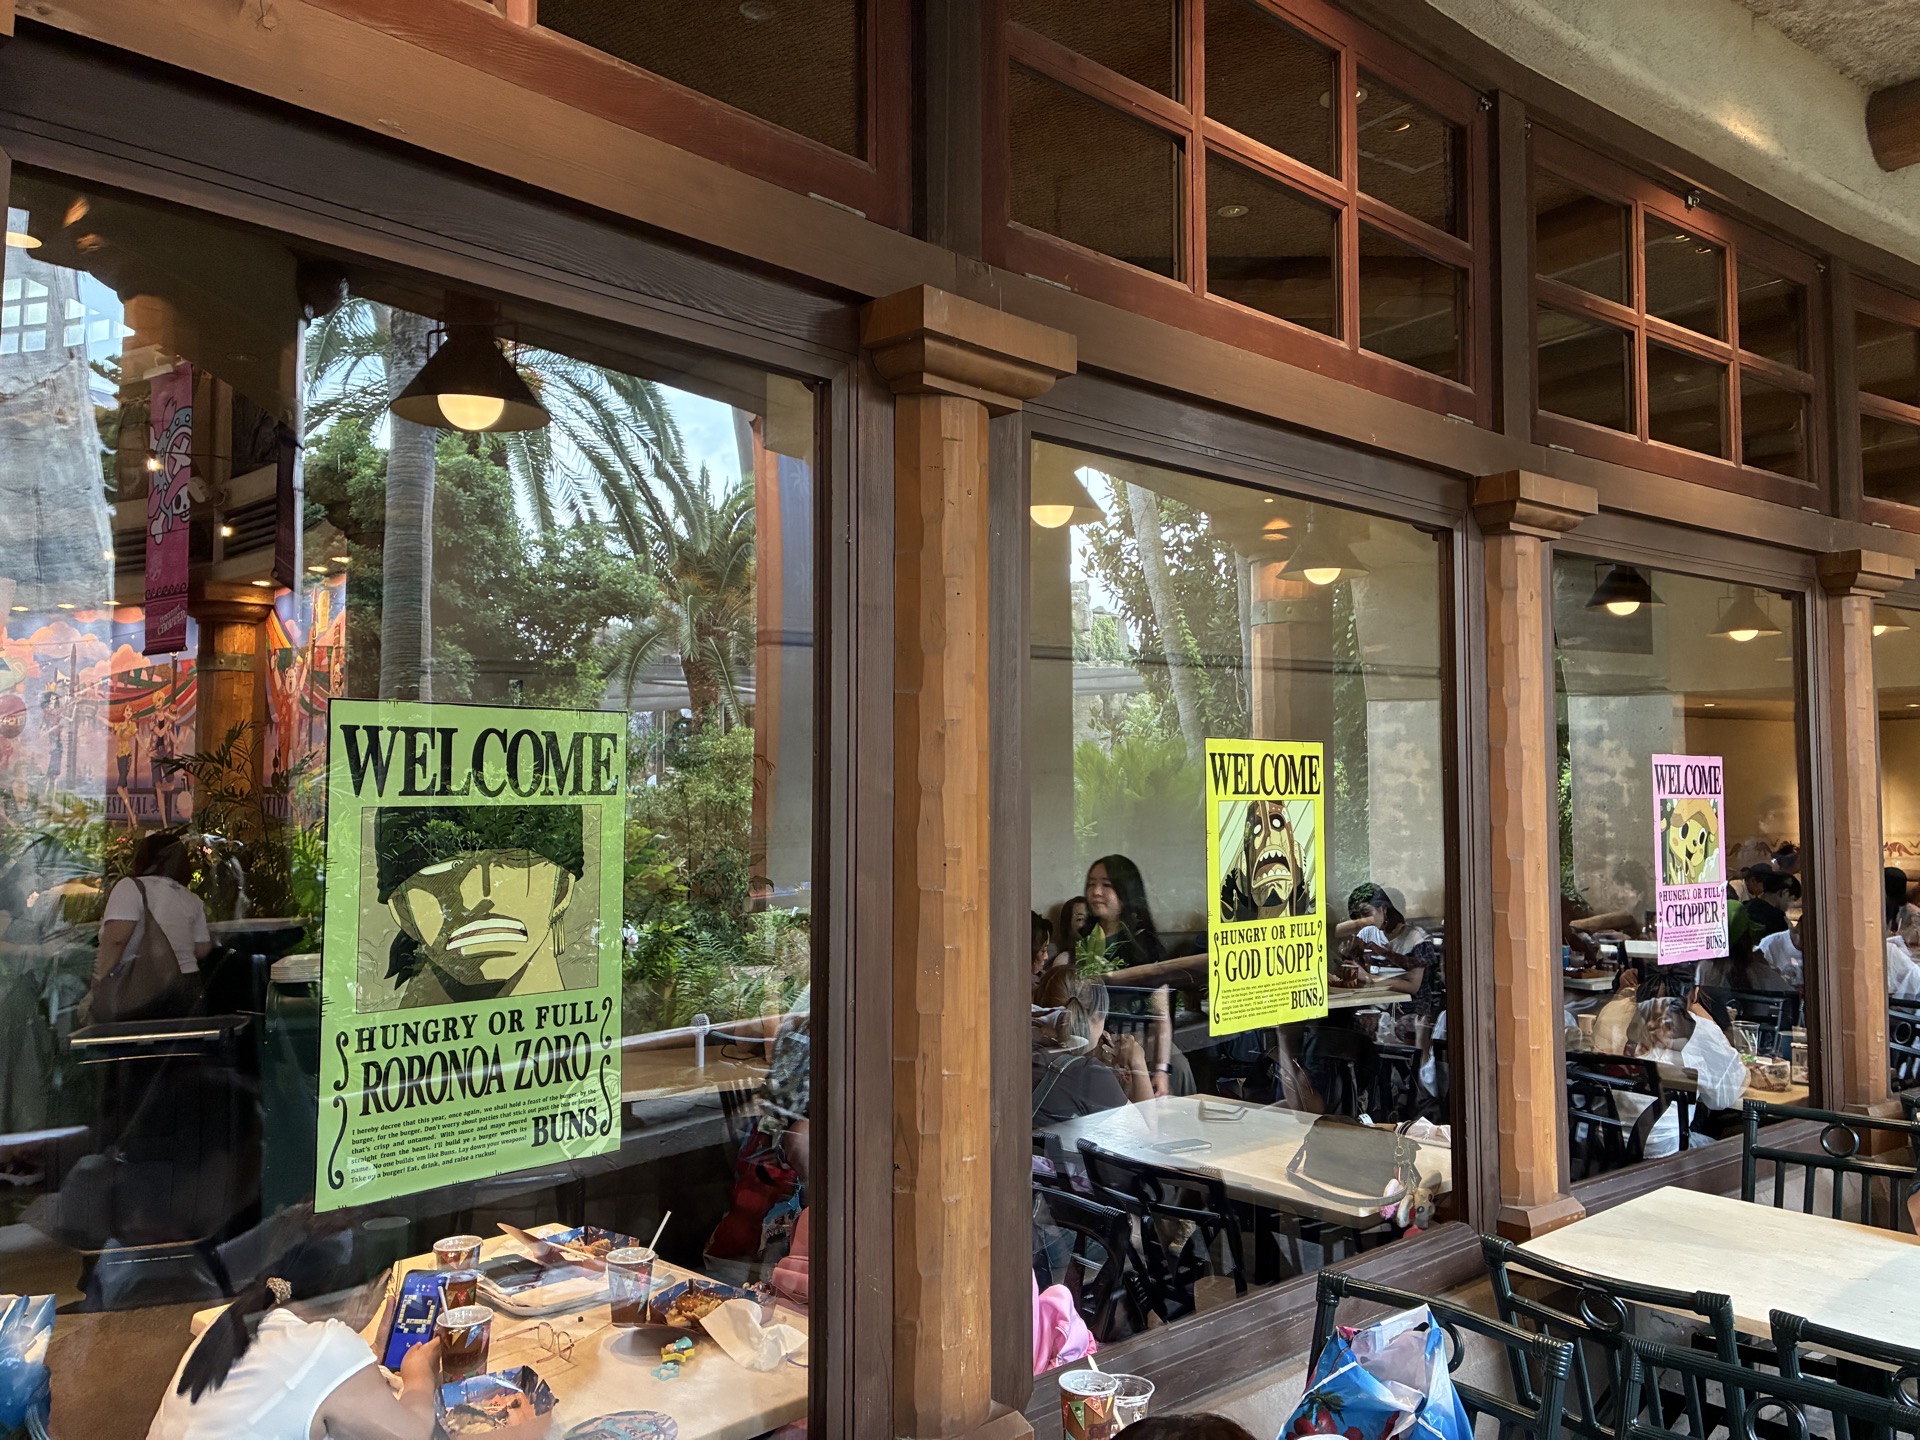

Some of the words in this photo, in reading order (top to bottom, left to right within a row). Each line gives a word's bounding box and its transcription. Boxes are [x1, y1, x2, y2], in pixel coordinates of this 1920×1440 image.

[340, 724, 619, 798] WELCOME
[1209, 752, 1320, 796] WELCOME
[1654, 764, 1722, 796] WELCOME
[1662, 888, 1690, 902] HUNGRY
[1693, 888, 1702, 899] OR
[1704, 886, 1721, 898] FULL
[1665, 901, 1719, 928] CHOPPER
[1220, 926, 1267, 946] HUNGRY
[1271, 925, 1286, 941] OR
[1290, 921, 1316, 938] FULL
[1706, 935, 1722, 950] BUNS
[1225, 947, 1262, 982] GOD
[1266, 942, 1314, 976] USOPP
[1291, 988, 1318, 1010] BUNS
[354, 1014, 478, 1053] HUNGRY
[488, 1009, 525, 1035] OR
[535, 1000, 598, 1030] FULL
[359, 1043, 506, 1116] RORONOA
[514, 1031, 592, 1090] ZORO
[357, 1126, 379, 1134] hereby
[464, 1109, 482, 1117] again,
[408, 1134, 436, 1144] untamed.
[508, 1117, 527, 1127] poured
[424, 1124, 440, 1132] Don't
[461, 1117, 477, 1125] about
[479, 1114, 498, 1123] patties
[538, 1104, 549, 1112] past
[531, 1106, 597, 1147] BUNS
[351, 1154, 377, 1164] straight
[412, 1144, 431, 1153] heart,
[500, 1128, 517, 1136] worth
[501, 1135, 526, 1145] weapons!
[382, 1167, 405, 1177] burger!
[421, 1161, 440, 1169] drink,
[475, 1150, 496, 1159] ruckus!
